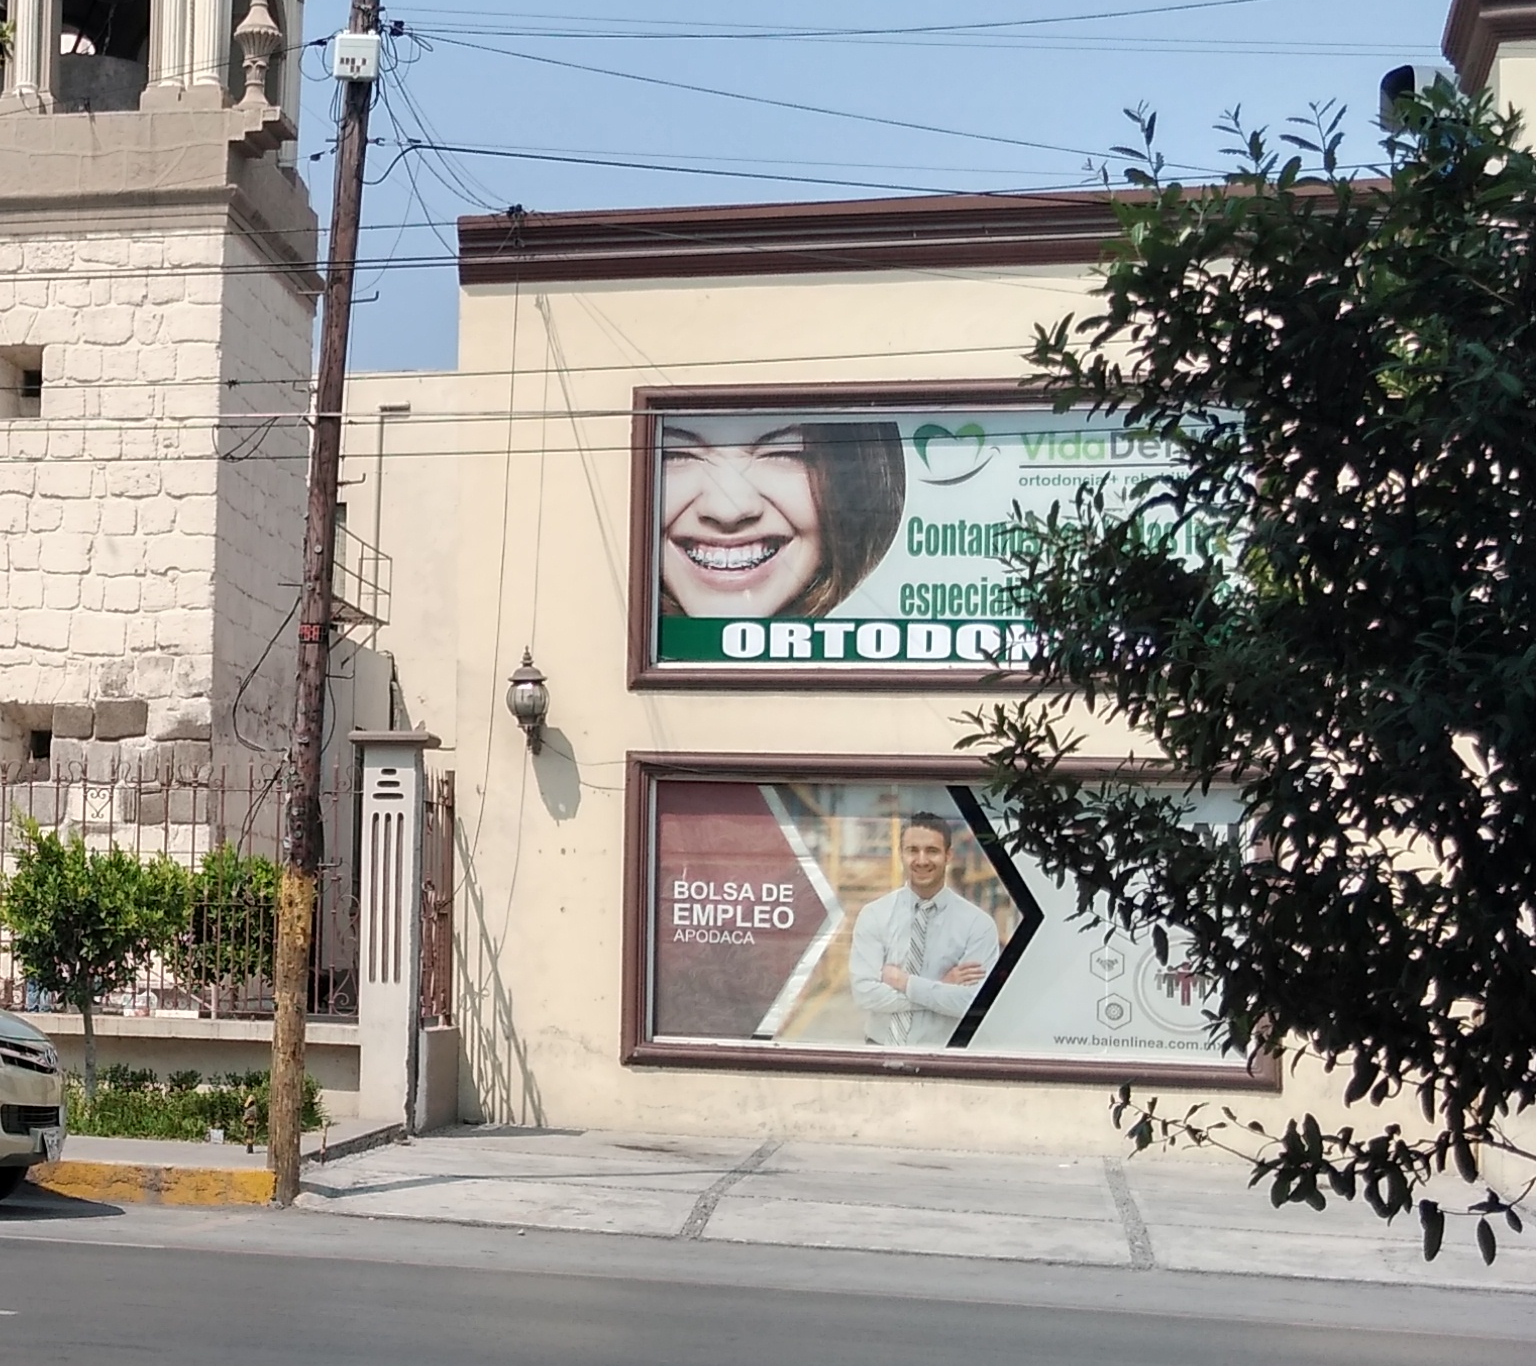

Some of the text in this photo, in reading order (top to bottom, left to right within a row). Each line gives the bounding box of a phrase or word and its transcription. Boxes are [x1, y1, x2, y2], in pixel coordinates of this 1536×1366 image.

[673, 880, 794, 903] BOLSA DE
[672, 902, 795, 930] EMPLEO
[672, 928, 756, 945] APODACA
